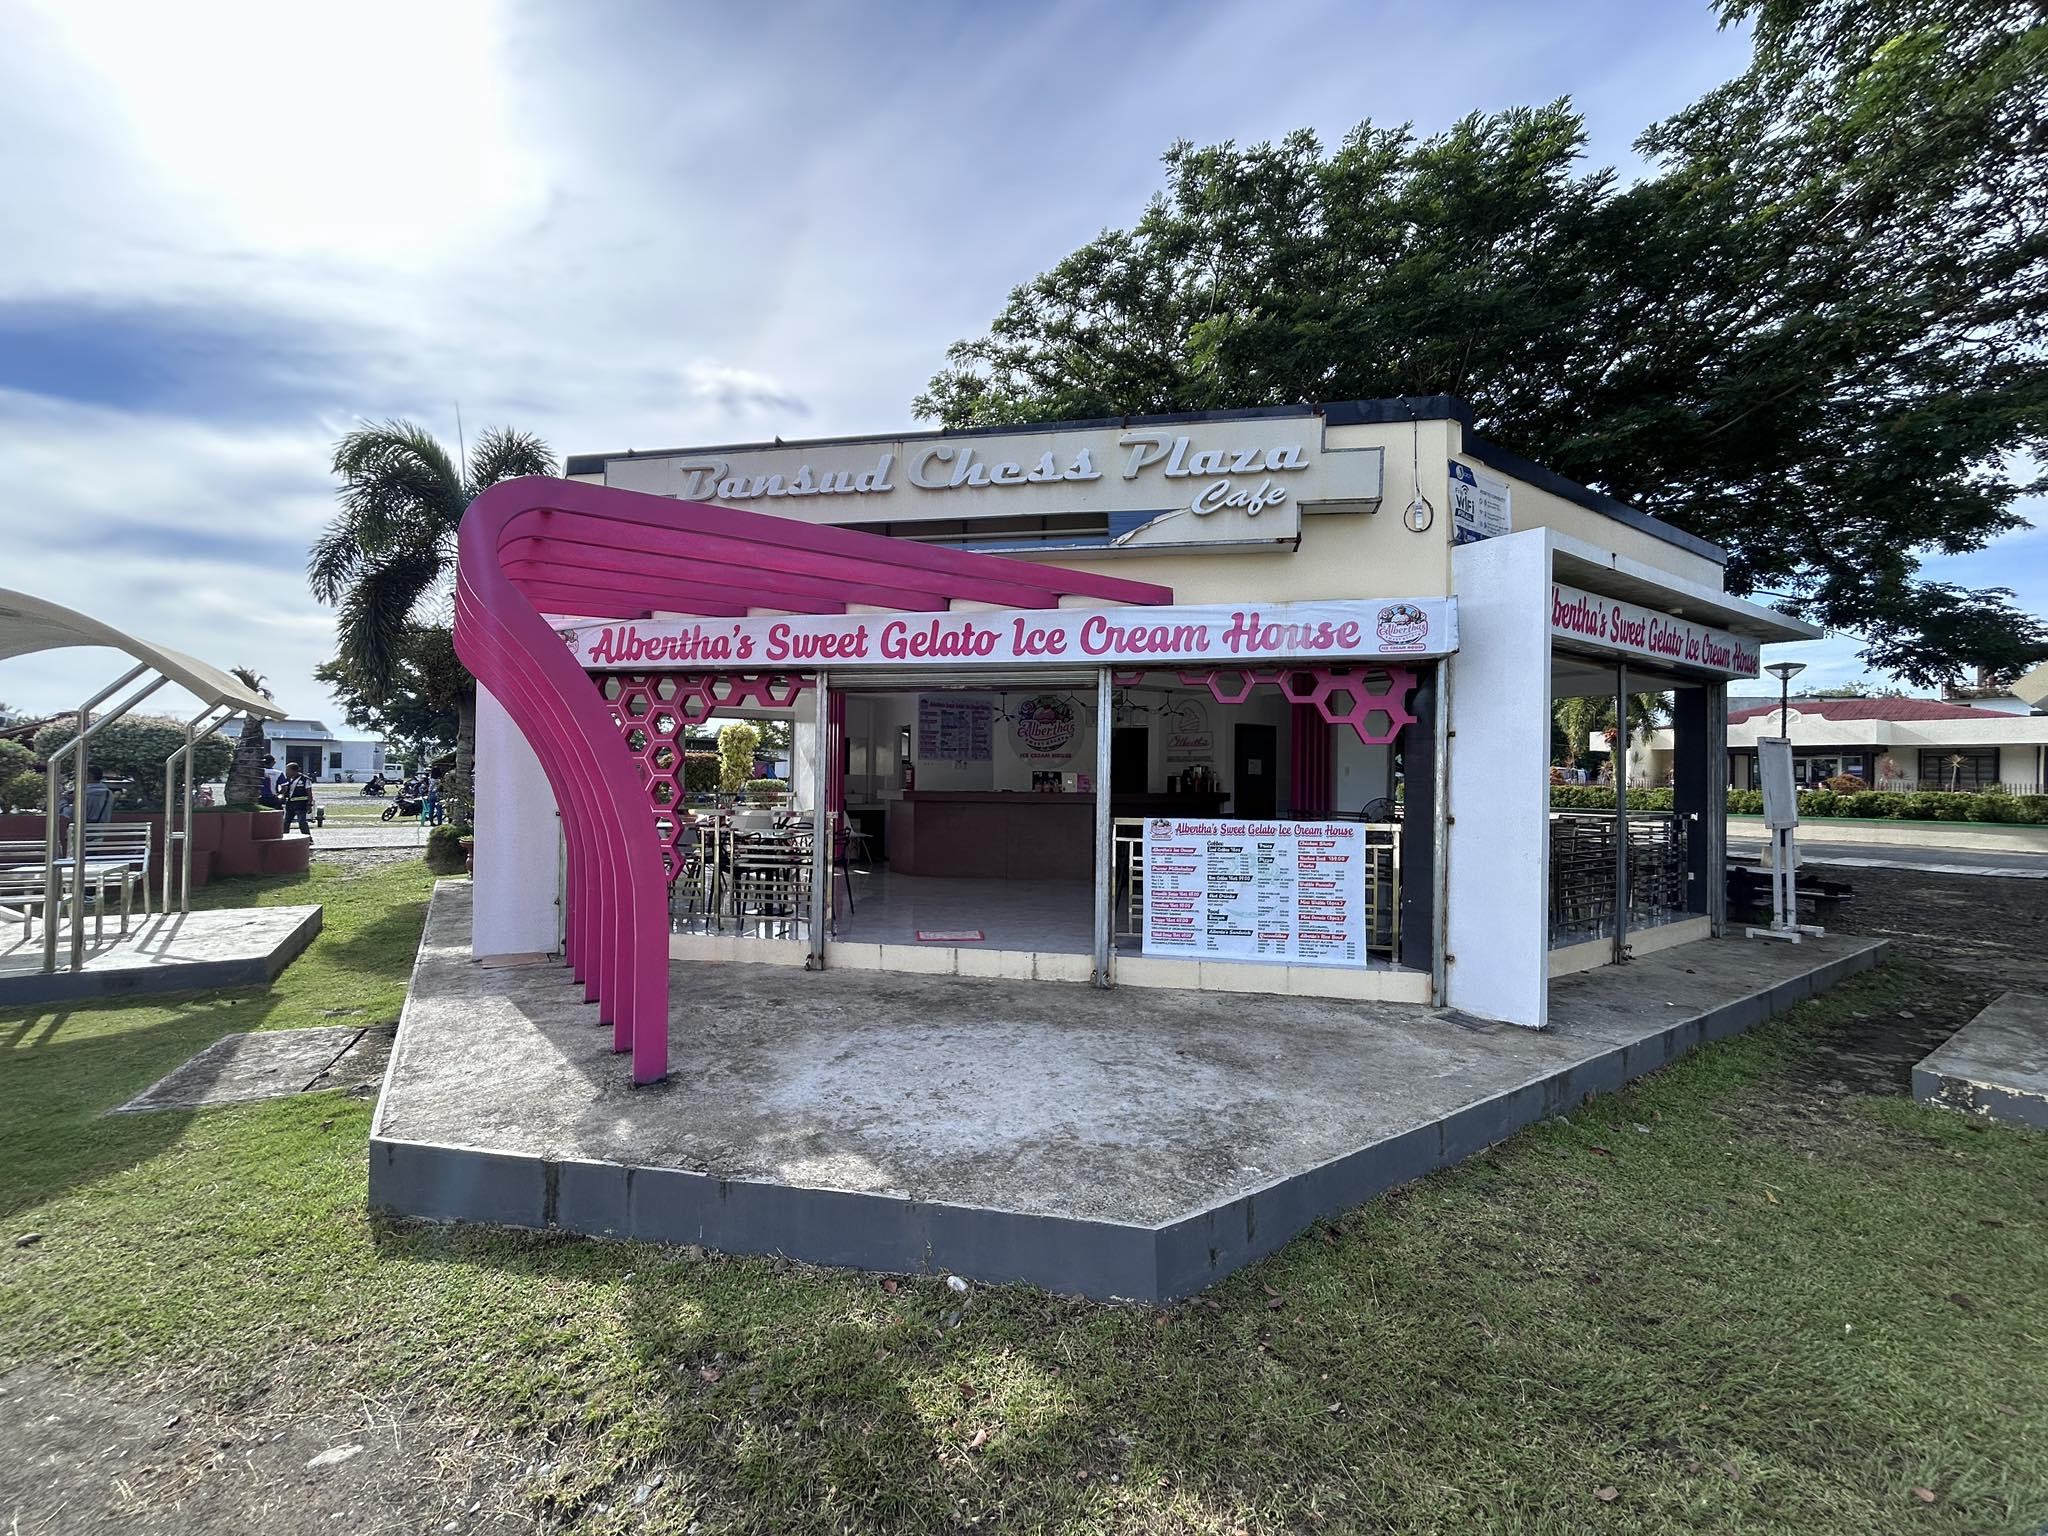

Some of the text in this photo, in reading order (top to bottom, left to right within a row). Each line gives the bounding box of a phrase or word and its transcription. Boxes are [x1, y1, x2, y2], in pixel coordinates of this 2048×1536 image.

[680, 432, 1310, 501] Bansud Chess Plaza
[1190, 478, 1288, 517] Cafe
[588, 611, 1362, 664] Albertha's Sweet Gelato Ice Cream House
[1610, 606, 1646, 648] Sweet
[1648, 617, 1684, 656] Gelato
[1685, 627, 1700, 661] Ice
[1702, 633, 1730, 668] Cream
[1732, 641, 1758, 675] House
[1175, 822, 1354, 837] Albertha's Sweet Gelato Ice Cream House
